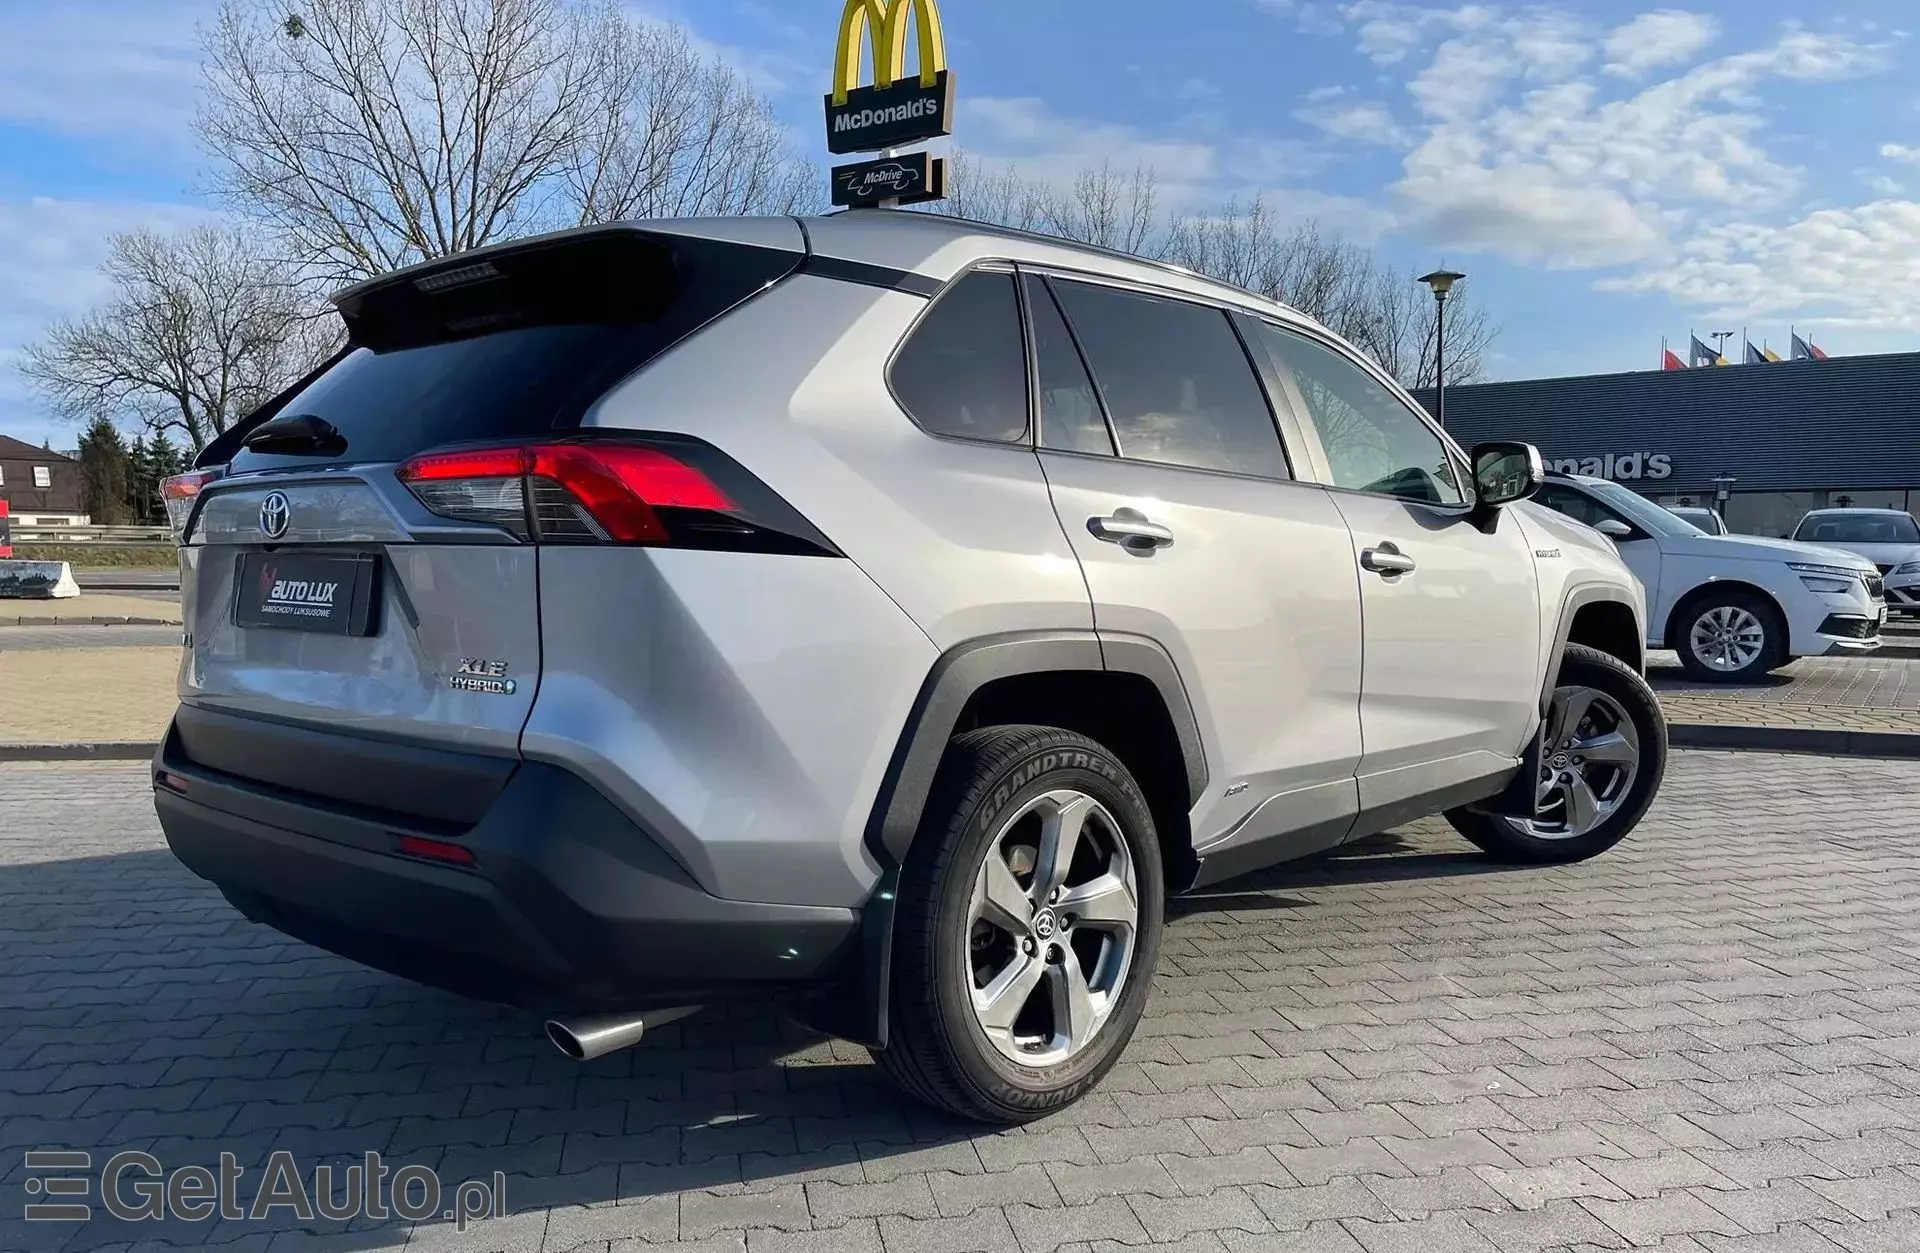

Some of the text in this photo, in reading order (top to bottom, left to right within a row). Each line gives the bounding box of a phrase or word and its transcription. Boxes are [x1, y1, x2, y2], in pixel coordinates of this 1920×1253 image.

[834, 98, 937, 132] McDonald's
[864, 169, 902, 184] McDrive
[307, 582, 338, 602] LUX
[261, 605, 331, 617] SAMOCHODY LUKSUSOWE
[458, 658, 506, 677] XLE
[449, 677, 503, 693] HYBRID
